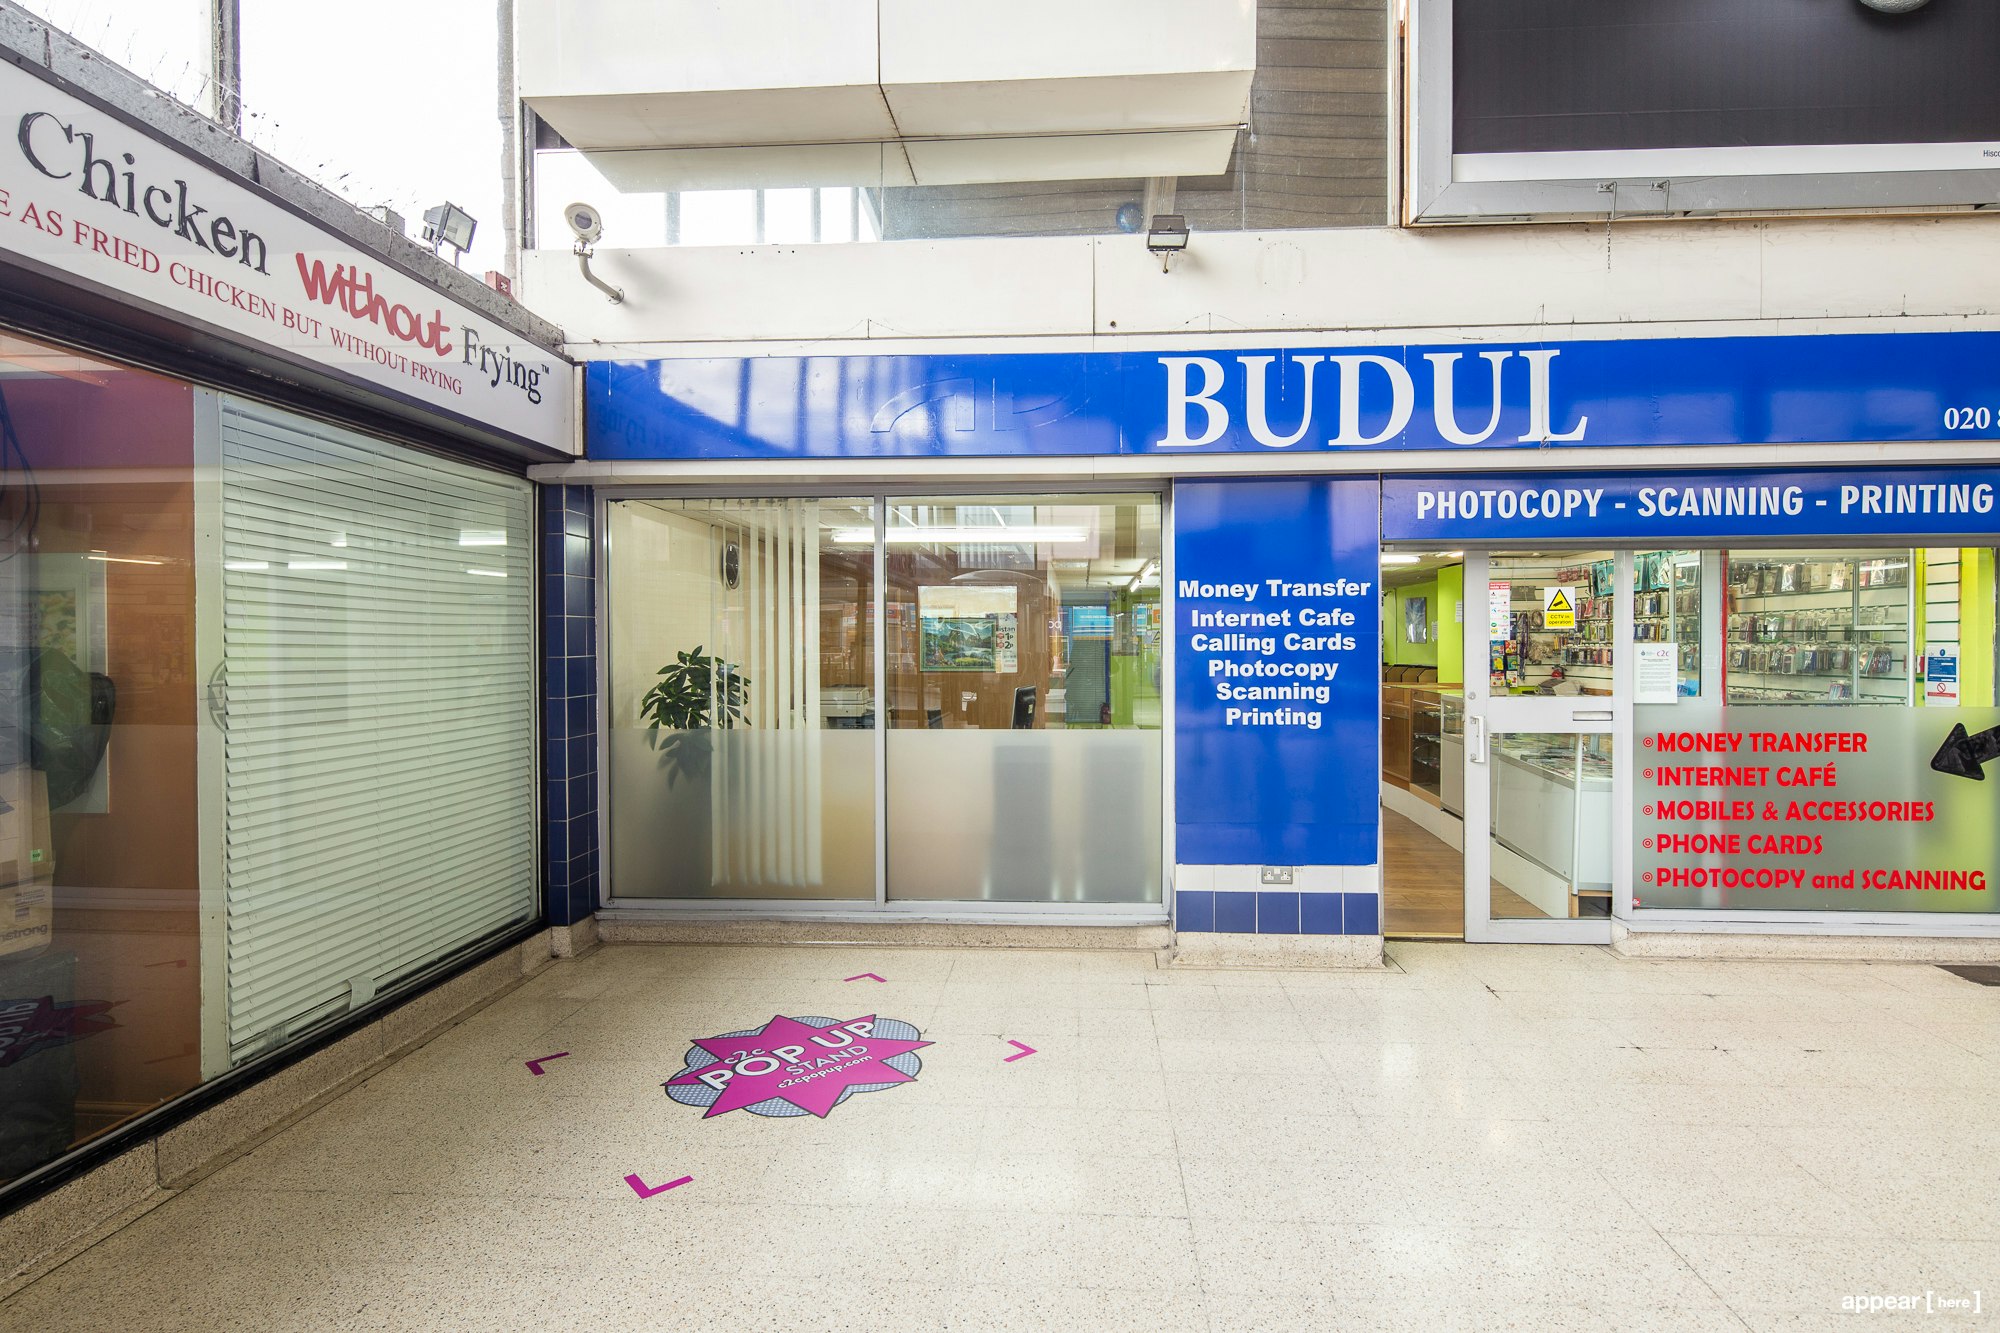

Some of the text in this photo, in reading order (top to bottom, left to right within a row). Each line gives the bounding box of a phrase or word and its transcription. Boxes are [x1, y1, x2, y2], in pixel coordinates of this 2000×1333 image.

[18, 112, 270, 277] Chicken
[461, 325, 541, 404] Frying
[20, 203, 63, 236] AS
[73, 220, 160, 274] FRIED
[169, 262, 275, 321] CHICKEN
[282, 307, 321, 339] BUT
[330, 326, 408, 374] WITHOUT
[411, 361, 462, 395] FRYING
[1157, 350, 1588, 448] BUDUL
[1944, 407, 1990, 430] 020
[1417, 488, 1604, 519] PHOTOCOPY
[1637, 487, 1804, 517] SCANNING
[1840, 484, 1994, 515] PRINTING
[1179, 578, 1371, 601] Money Transfer
[1191, 608, 1355, 627] Internet Cafe
[1191, 633, 1356, 655] Calling Cards
[1208, 659, 1338, 680] Photocopy
[1216, 682, 1330, 704] Scanning
[1226, 707, 1321, 729] Printing
[1657, 732, 1867, 752] MONEY TRANSFER
[1657, 762, 1836, 787] INTERNET CAFÉ
[1657, 800, 1935, 821] MOBILES & ACCESSORIES
[1656, 834, 1823, 854] PHONE CARDS
[1656, 867, 1986, 890] PHOTOCOPY and SCANNING
[697, 1021, 875, 1090] POP UP
[723, 1048, 766, 1065] c2c
[785, 1045, 868, 1076] STAND
[777, 1055, 873, 1089] c2cpopup.com
